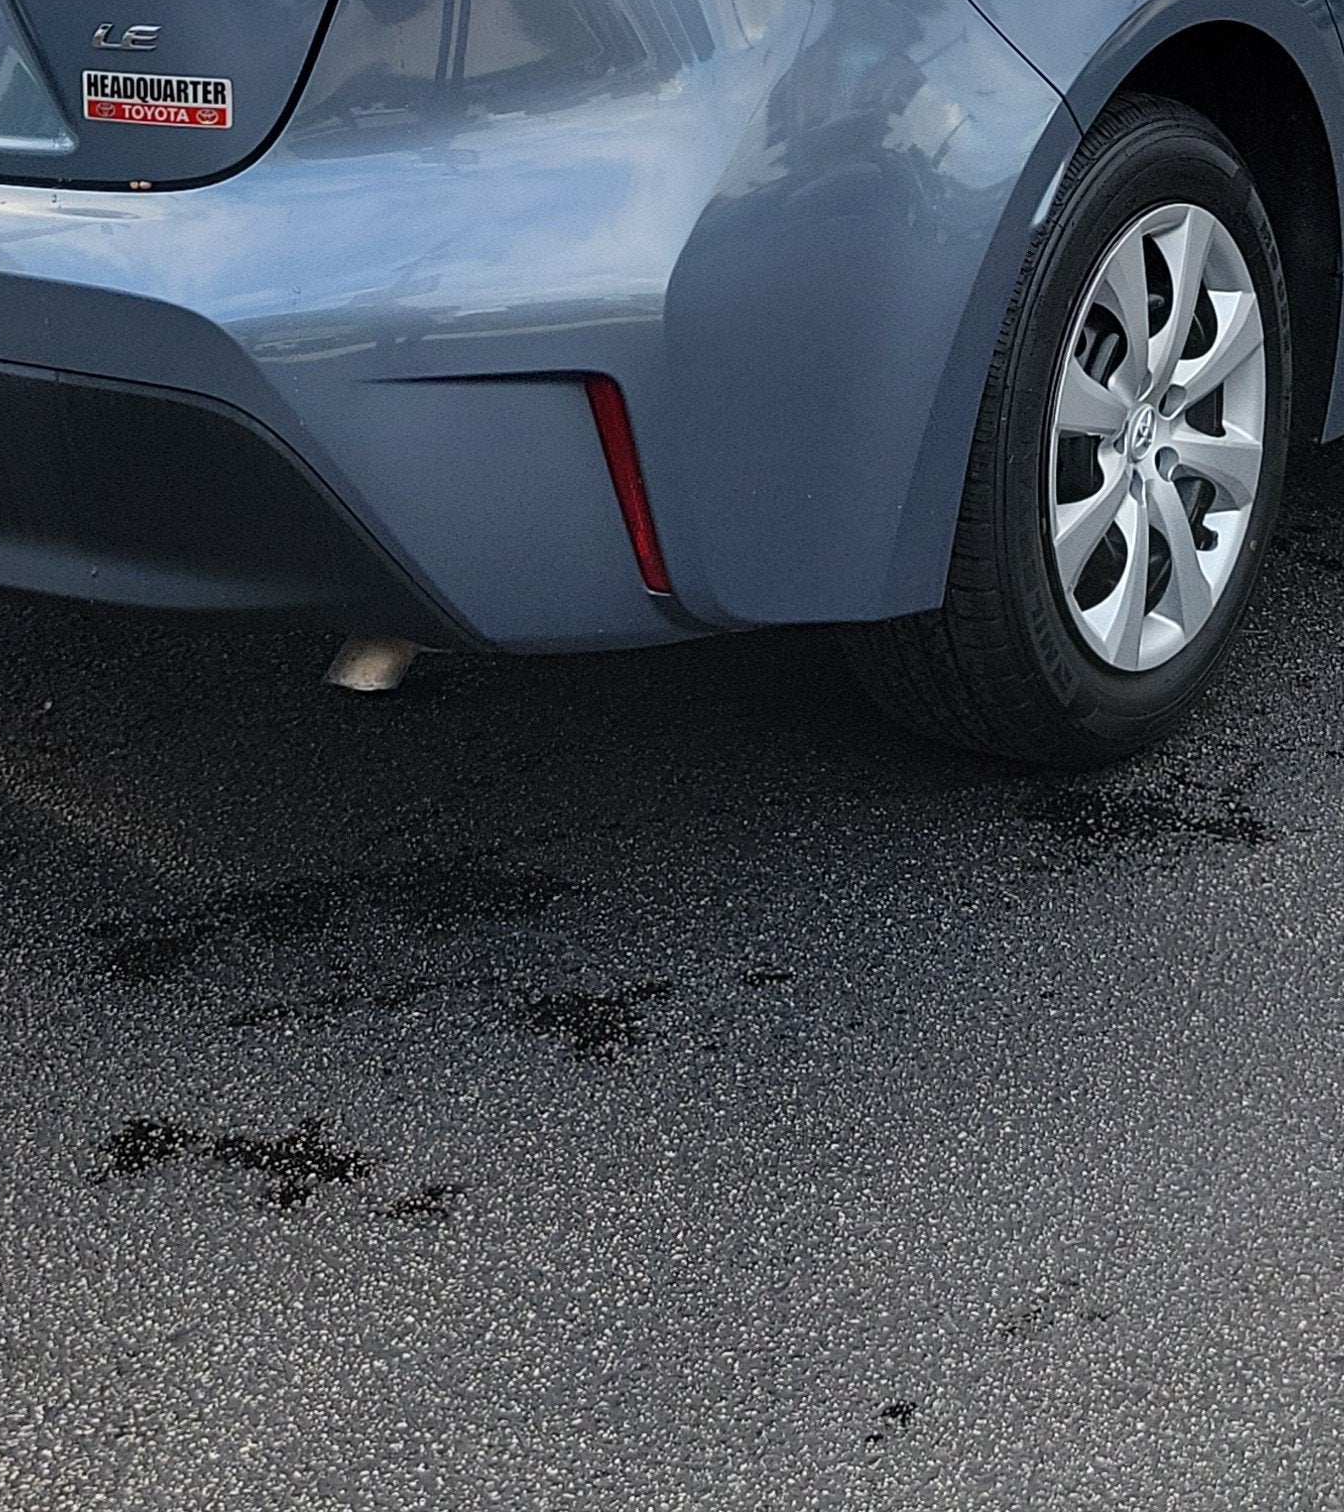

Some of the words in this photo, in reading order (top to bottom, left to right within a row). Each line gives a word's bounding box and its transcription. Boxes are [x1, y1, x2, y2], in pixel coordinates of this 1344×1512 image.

[91, 23, 162, 50] LE
[86, 73, 227, 105] HEADQUARTER
[122, 105, 190, 122] TOYOTA
